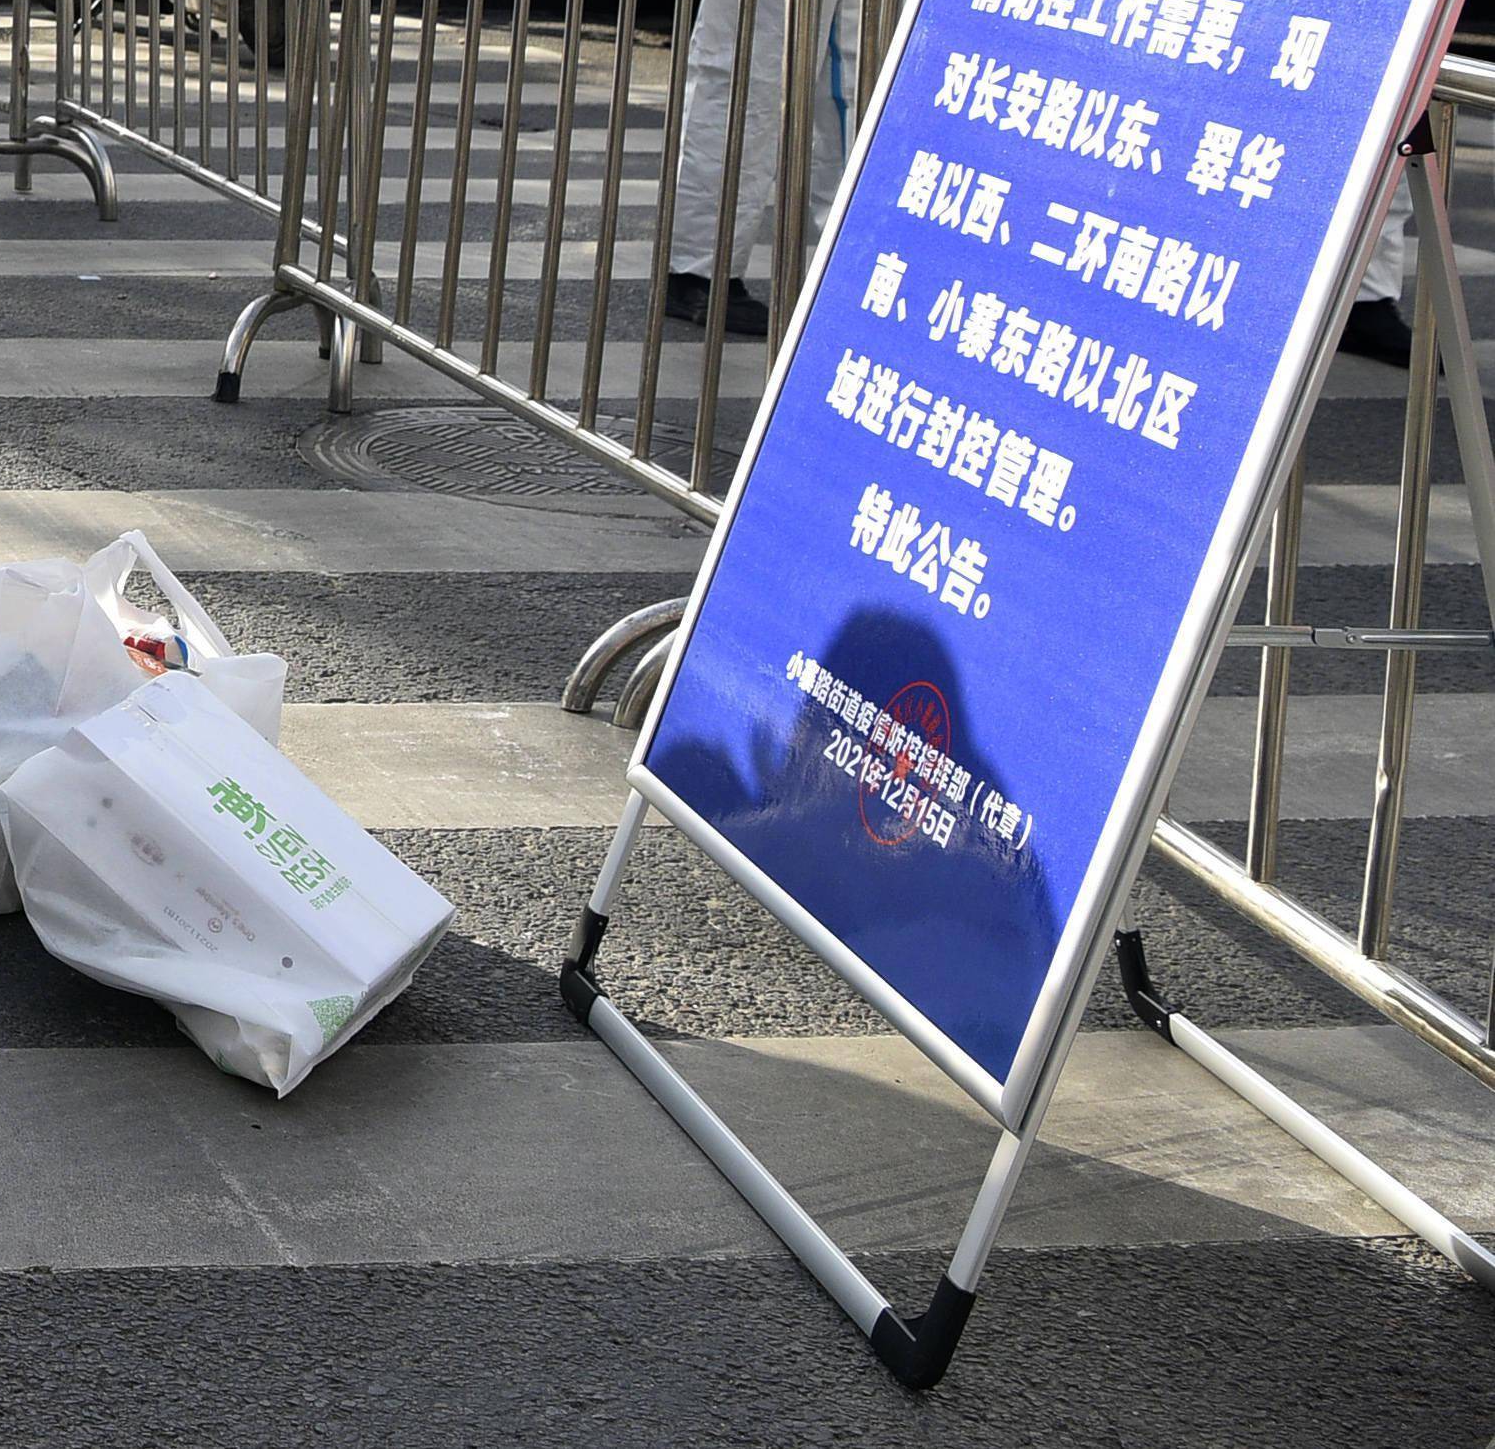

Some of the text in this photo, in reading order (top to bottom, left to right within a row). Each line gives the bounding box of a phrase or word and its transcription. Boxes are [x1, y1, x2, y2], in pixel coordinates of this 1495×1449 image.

[933, 51, 1286, 209] 对长安路以东、翠华
[896, 149, 1241, 332] 路以西、二环南路以
[860, 251, 1199, 451] 南、小寨东路以北区
[824, 347, 1078, 533] 域进行封控管理。
[849, 481, 992, 620] 特此公告。
[822, 728, 957, 849] 2021年12月15日
[279, 848, 337, 895] RESH
